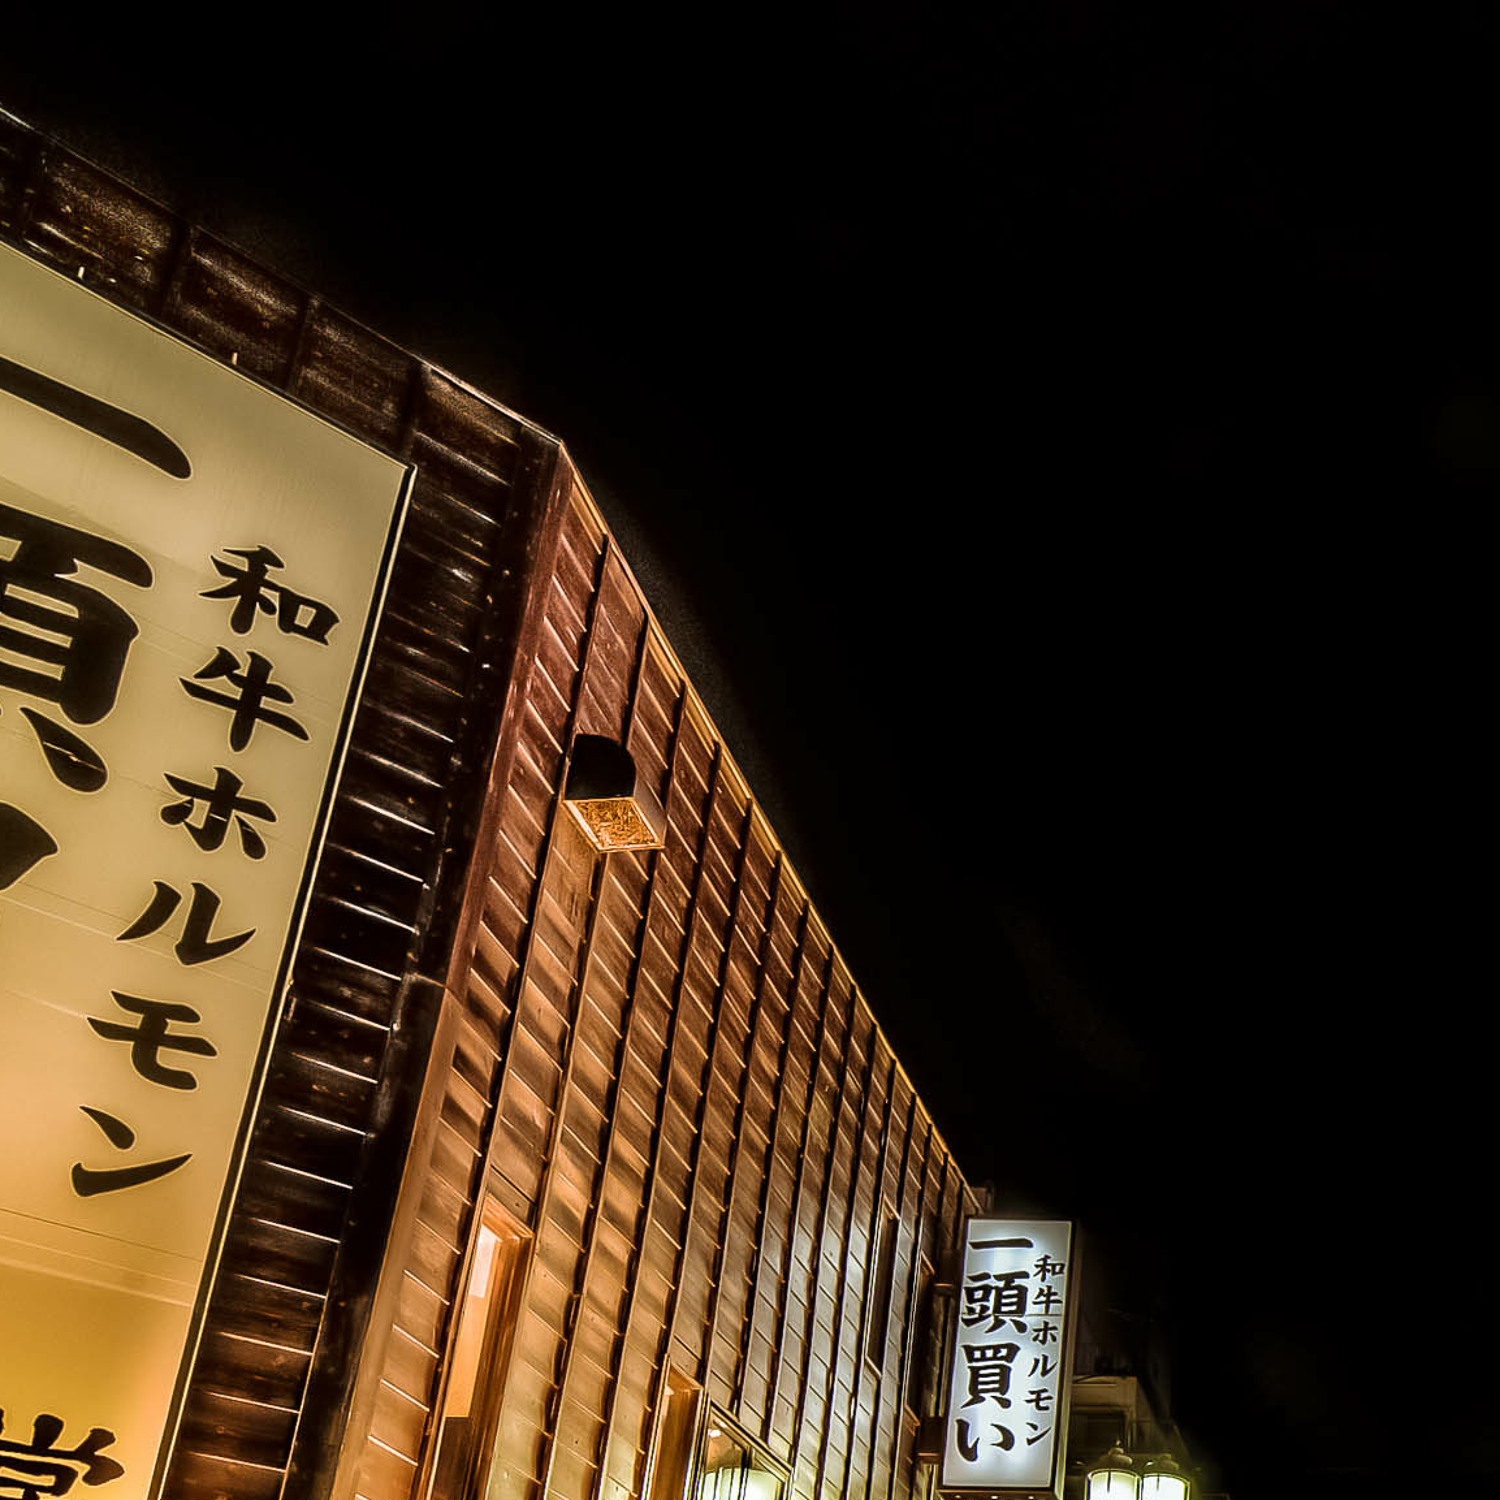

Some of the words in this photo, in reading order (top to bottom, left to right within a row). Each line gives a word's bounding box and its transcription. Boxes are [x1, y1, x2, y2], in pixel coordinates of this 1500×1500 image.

[70, 543, 341, 1197] 和牛ホルモン
[954, 1237, 1034, 1463] 一頭買い
[1024, 1254, 1066, 1447] 和牛ホルモン
